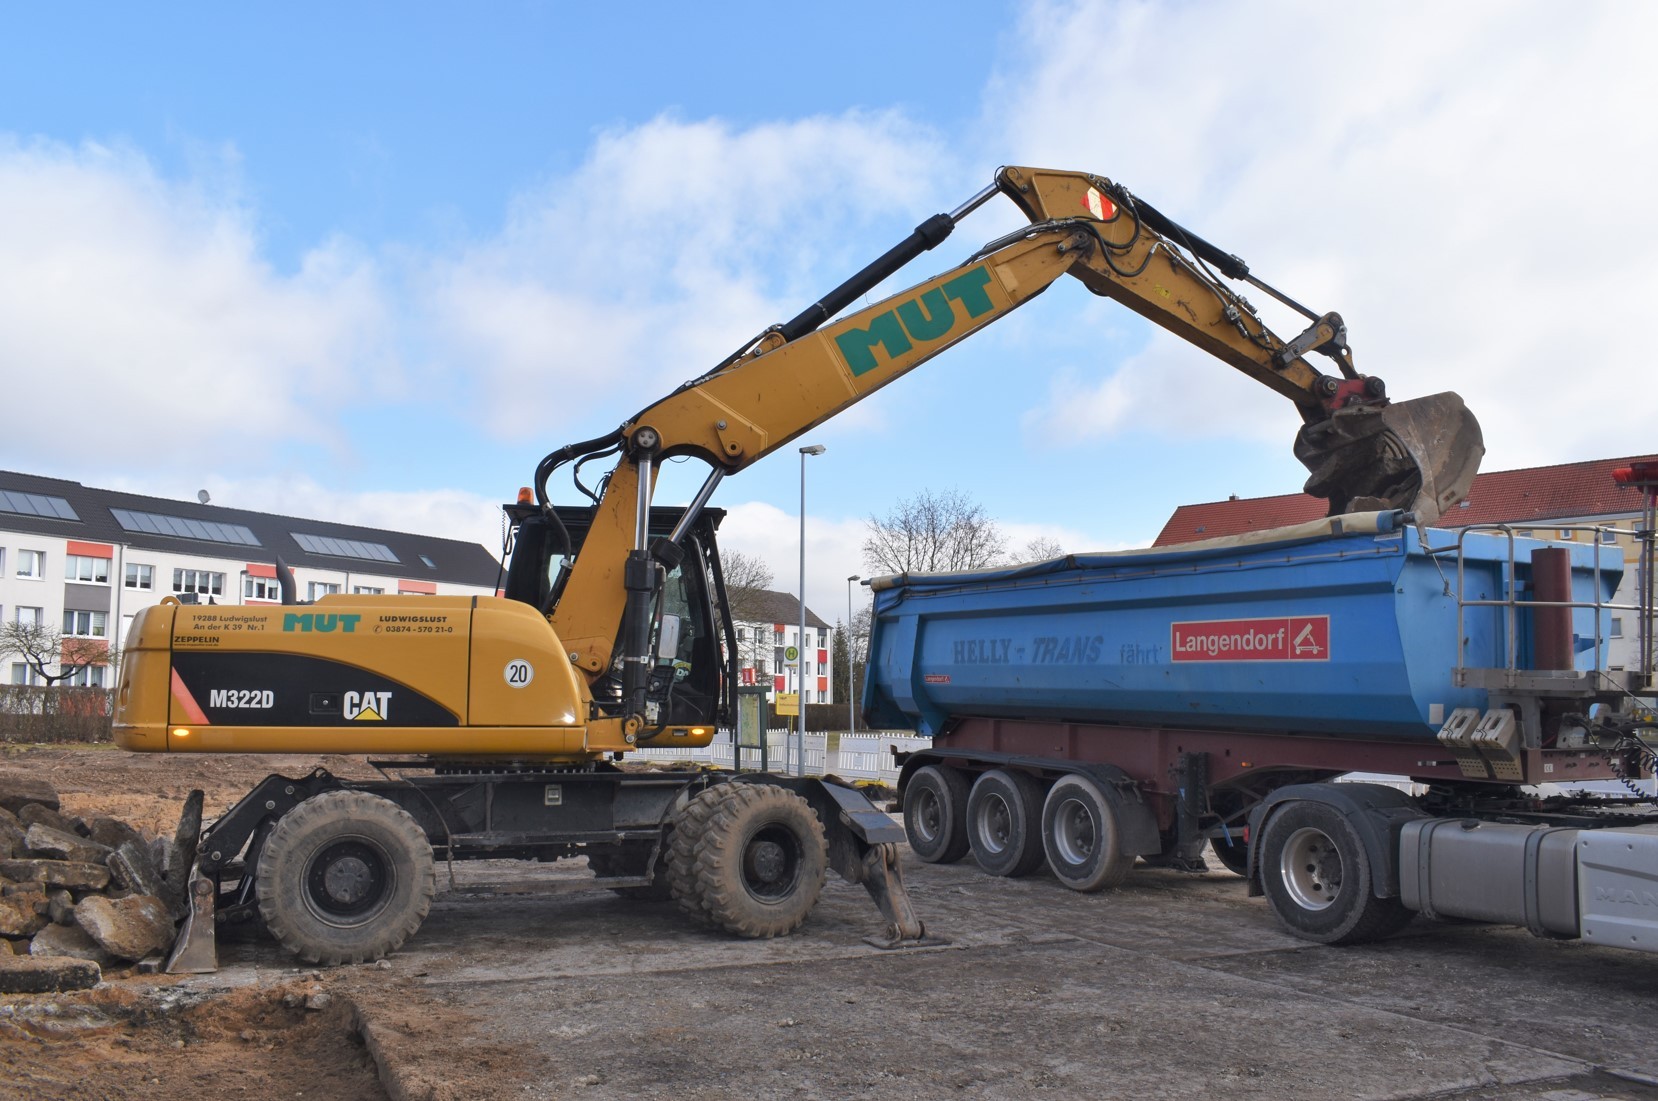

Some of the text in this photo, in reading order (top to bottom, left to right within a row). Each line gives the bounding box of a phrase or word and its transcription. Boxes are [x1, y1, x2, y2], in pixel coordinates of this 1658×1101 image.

[834, 265, 994, 377] MUT
[207, 623, 221, 631] der
[219, 615, 268, 623] Ludwigslust
[282, 613, 361, 633] MUT
[379, 615, 448, 623] LUDWIGSLUST
[386, 625, 411, 633] 03874
[417, 625, 433, 633] 570
[952, 639, 1012, 665] HELLY
[1031, 635, 1104, 665] TRANS
[1175, 627, 1285, 656] Langendorf
[788, 650, 795, 658] H
[510, 664, 528, 683] 20
[209, 689, 274, 709] M322D
[343, 691, 392, 721] CAT
